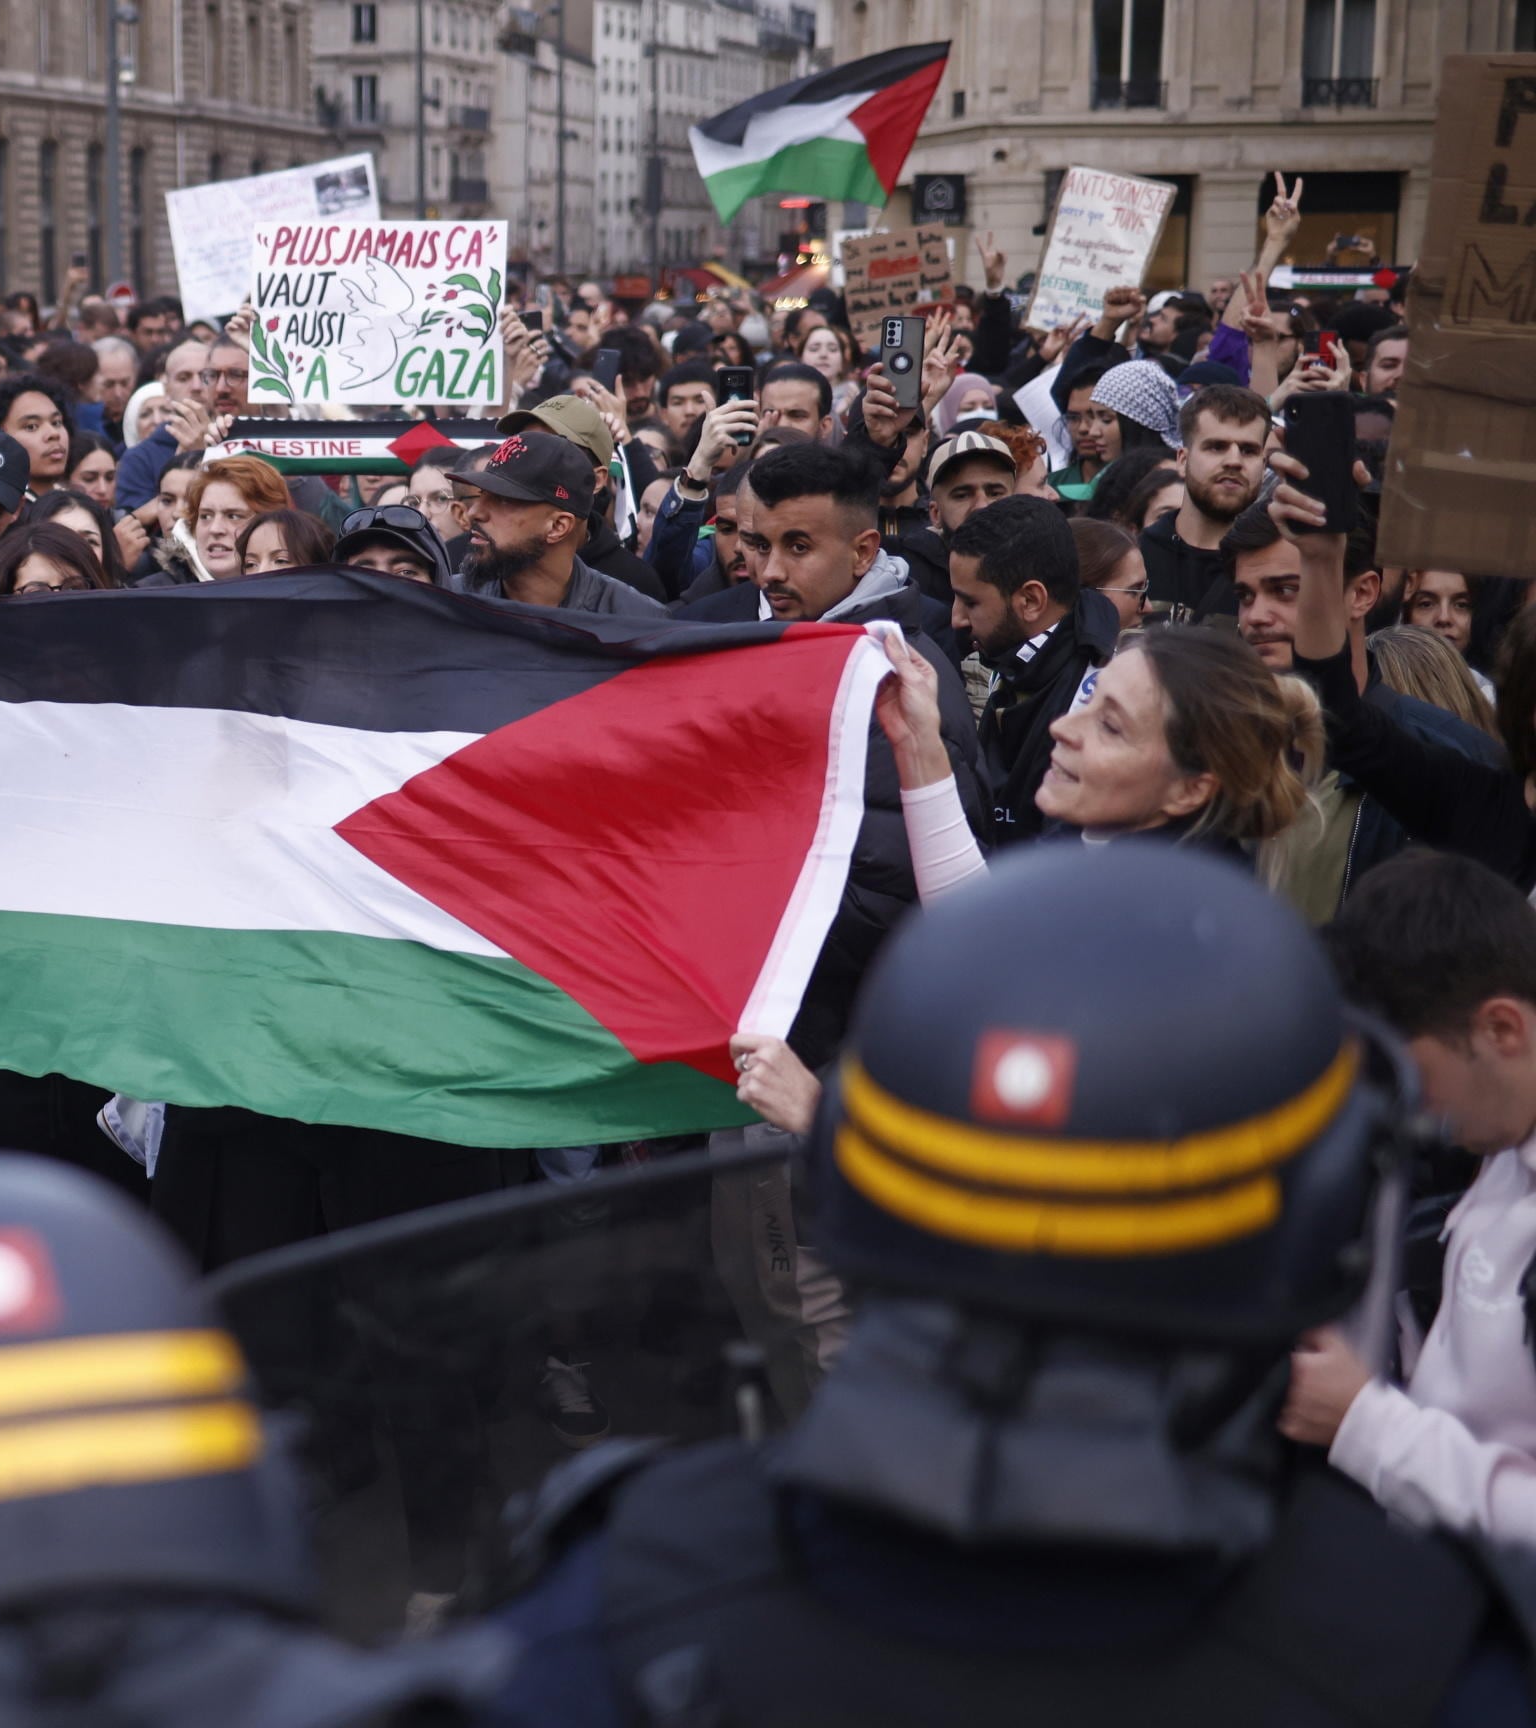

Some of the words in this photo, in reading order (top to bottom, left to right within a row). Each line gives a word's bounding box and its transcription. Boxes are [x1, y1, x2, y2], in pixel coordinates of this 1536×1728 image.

[1064, 172, 1170, 213] ANTISIONISTE
[333, 227, 440, 269] JAMAIS
[257, 271, 337, 308] VAUT
[284, 311, 345, 349] AUSSI
[303, 348, 330, 401] À
[394, 346, 496, 401] GAZA
[225, 439, 363, 456] PALESTINE
[767, 1214, 790, 1273] NIKE
